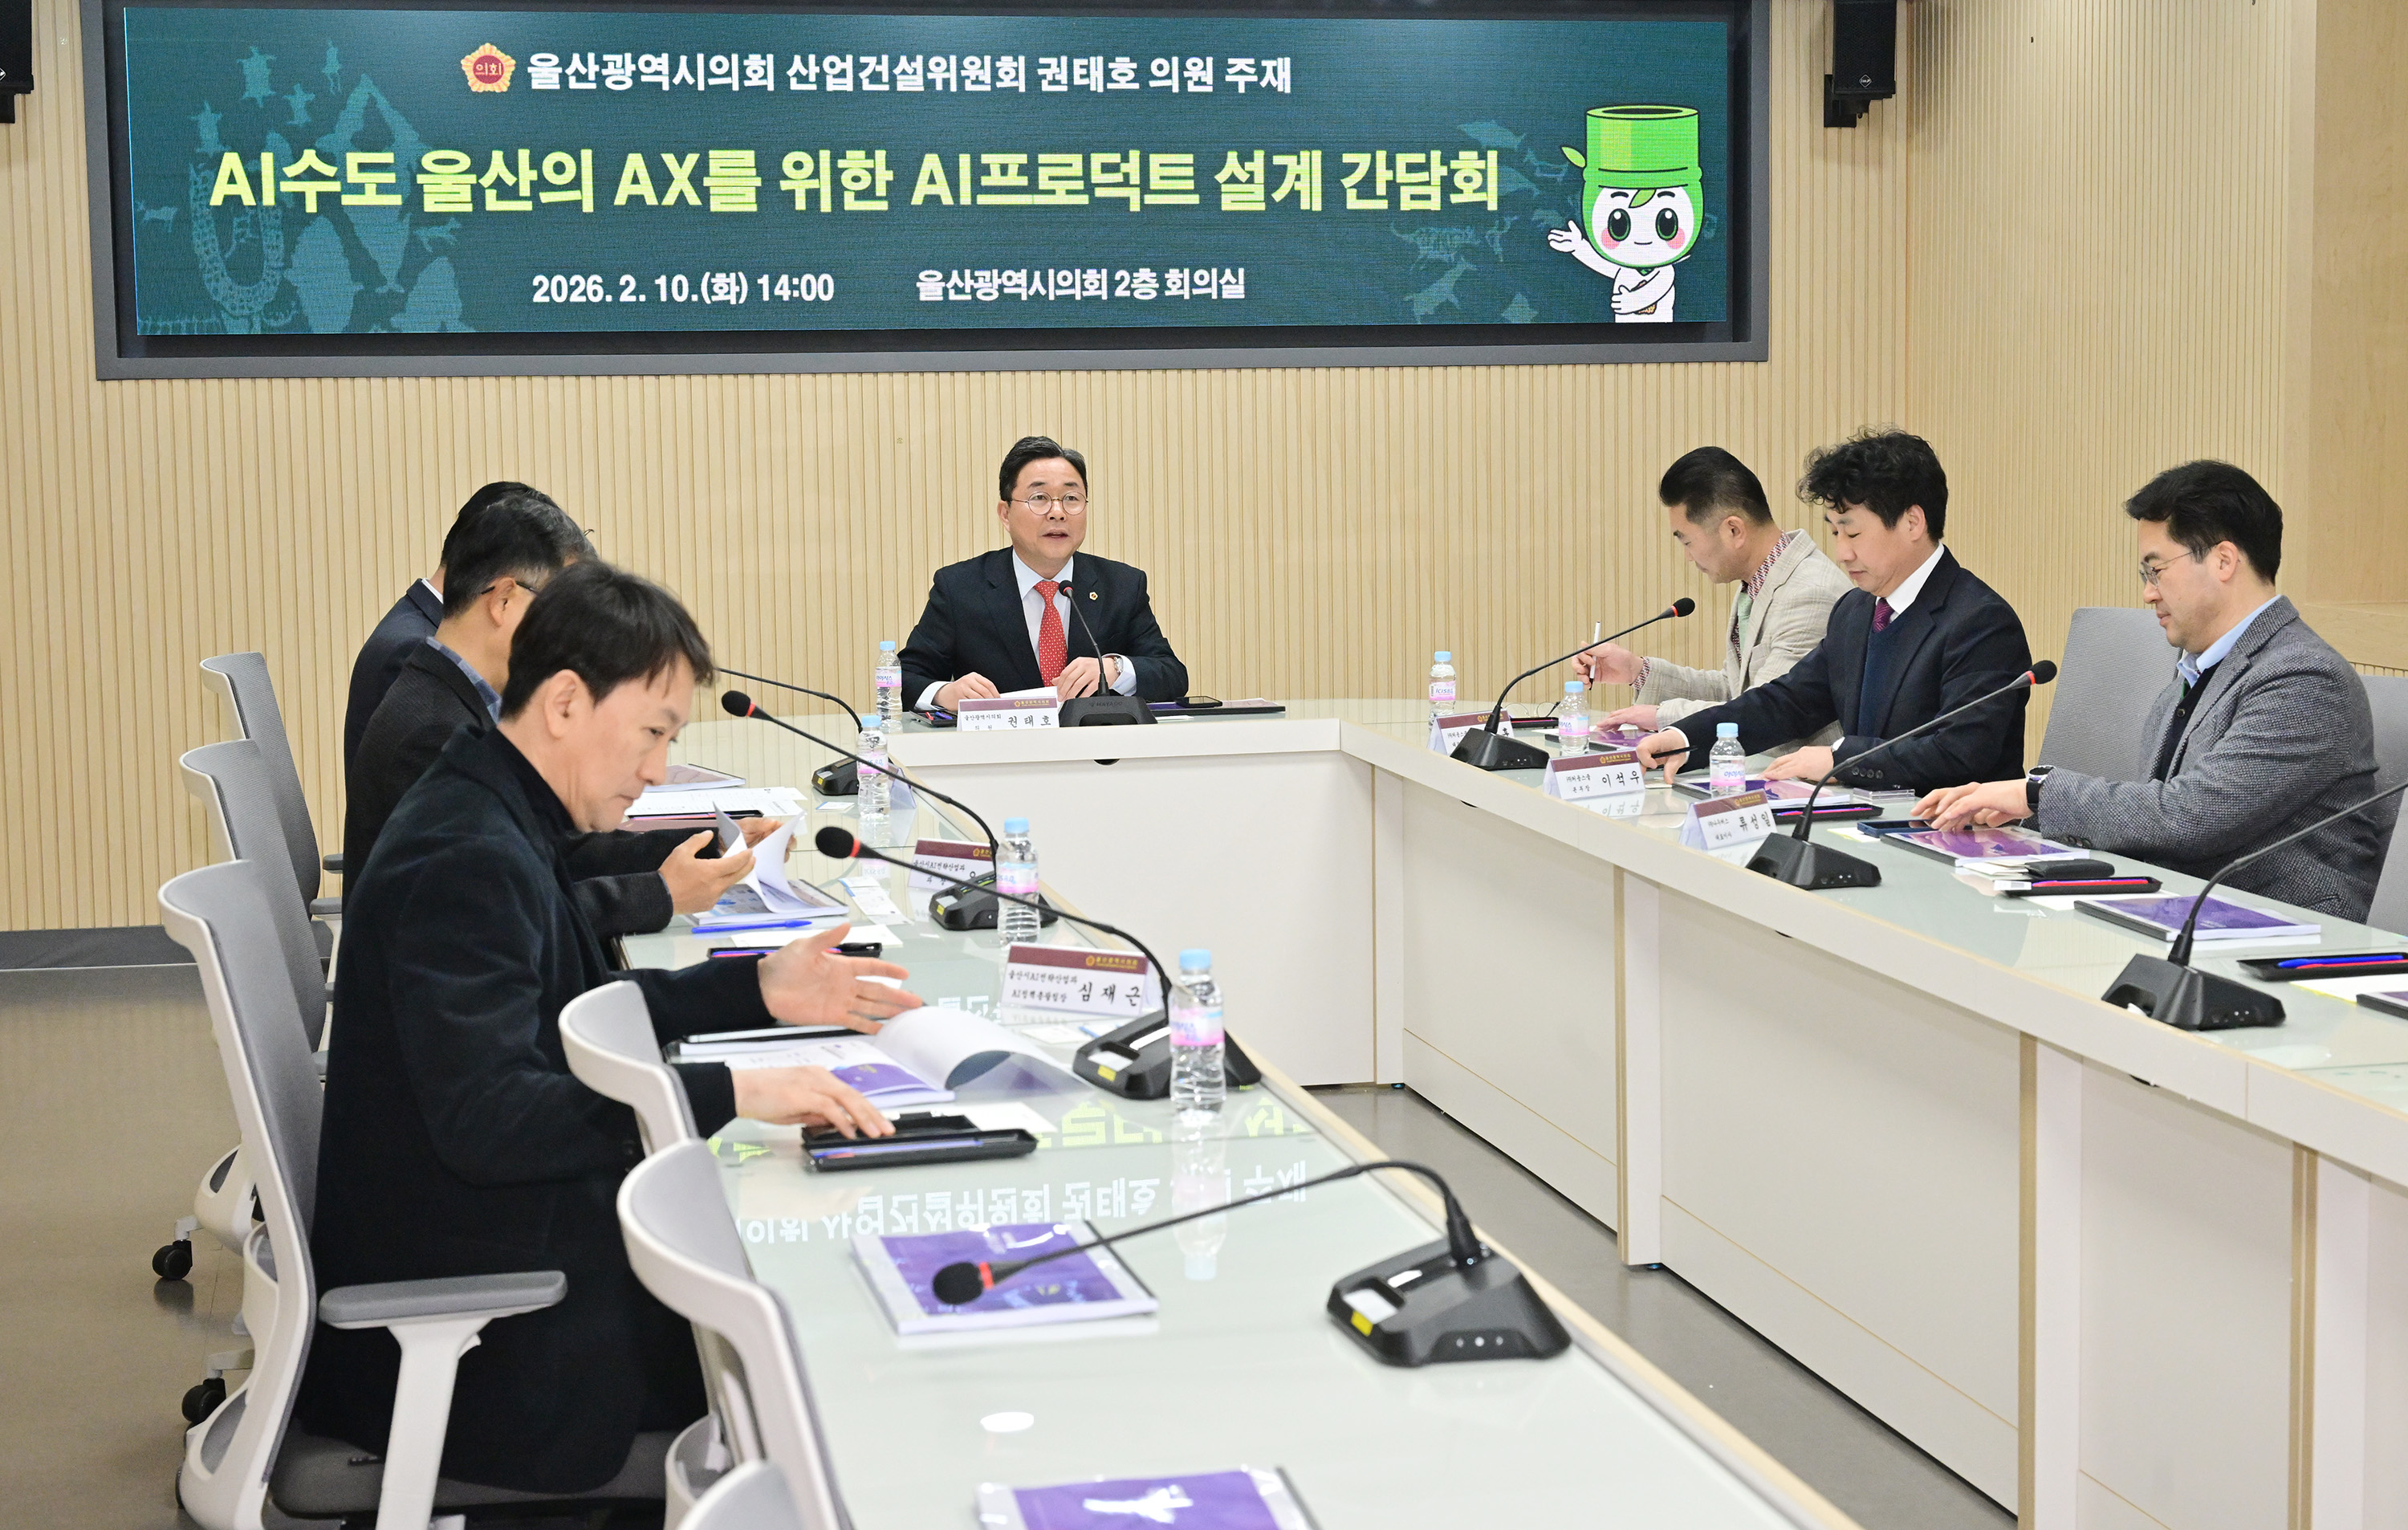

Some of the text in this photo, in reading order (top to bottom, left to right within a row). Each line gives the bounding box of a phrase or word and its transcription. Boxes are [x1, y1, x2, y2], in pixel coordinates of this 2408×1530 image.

[475, 62, 502, 77] 의회
[527, 52, 1291, 94] 울산광역시의회 산업건설위원회 권태호 의원 주재
[209, 149, 1499, 214] AI수도 울산의 AX를 위한 AI프로덕트 설계 간담회
[532, 272, 835, 305] 2026. 2. 10.(화) 14:00
[916, 268, 1245, 302] 울산광역시의회 2층 회의실
